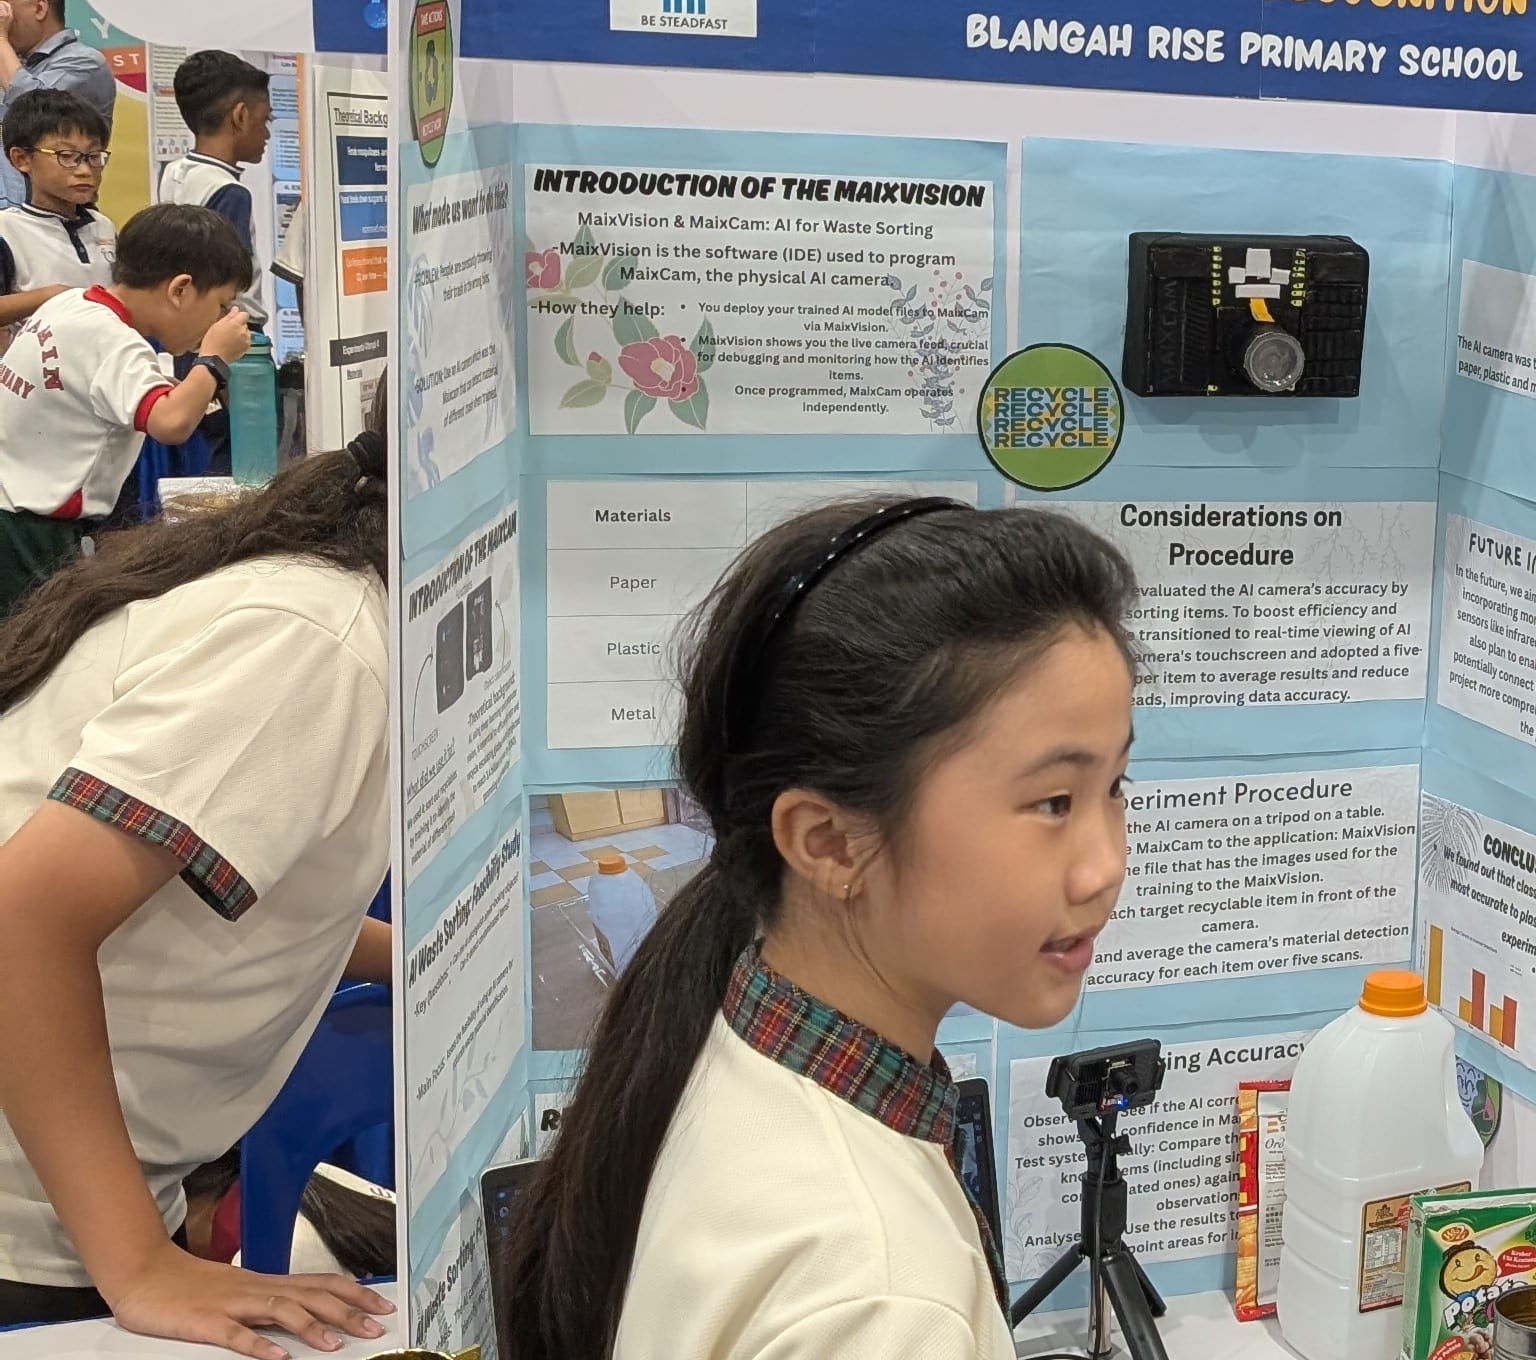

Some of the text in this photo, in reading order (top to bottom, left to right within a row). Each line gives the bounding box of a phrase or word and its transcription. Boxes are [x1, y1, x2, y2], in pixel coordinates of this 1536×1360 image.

[640, 14, 728, 31] BE STEADFAST
[966, 13, 1524, 82] BLANGAH RISE PRIMARY SCHOOL
[364, 108, 388, 126] Backg
[534, 168, 986, 208] INTRODUCTION OF THE MAIXVISION
[413, 202, 431, 234] What
[431, 197, 450, 229] made
[451, 204, 460, 223] us
[462, 195, 479, 220] want
[479, 190, 485, 215] to
[577, 212, 934, 239] MaixVision & MaixCam: AI for Waste Sorting
[552, 242, 956, 269] -MaixVision is the software (IDE) used to program
[620, 266, 893, 288] MaixCam, the physical AI camera.
[531, 300, 665, 319] -How they help:
[1457, 334, 1472, 351] The
[1473, 338, 1481, 354] AI
[1482, 343, 1513, 364] camera
[1514, 352, 1532, 368] was
[0, 363, 35, 399] MARY
[994, 388, 1109, 402] RECYCLE
[994, 403, 1109, 417] RECYCLE
[994, 418, 1109, 432] RECYCLE
[994, 433, 1109, 447] RECYCLE
[594, 507, 671, 523] Materials
[1120, 503, 1342, 528] Considerations on
[1169, 543, 1294, 567] Procedure
[1468, 532, 1522, 568] FUTURE
[409, 510, 517, 622] INTRODUCTION OF THE MAIXCAM
[609, 574, 657, 592] Paper
[1209, 582, 1234, 597] the
[1238, 582, 1253, 597] AI
[1257, 581, 1321, 597] camera's
[1325, 581, 1388, 600] accuracy
[1391, 580, 1408, 597] by
[606, 640, 660, 656] Plastic
[610, 706, 656, 722] Metal
[1125, 777, 1353, 810] eriment Procedure
[409, 828, 521, 989] AI Waste Sorting: Feasibility Study
[1165, 1051, 1201, 1072] ing
[1443, 1278, 1528, 1331] Pota
